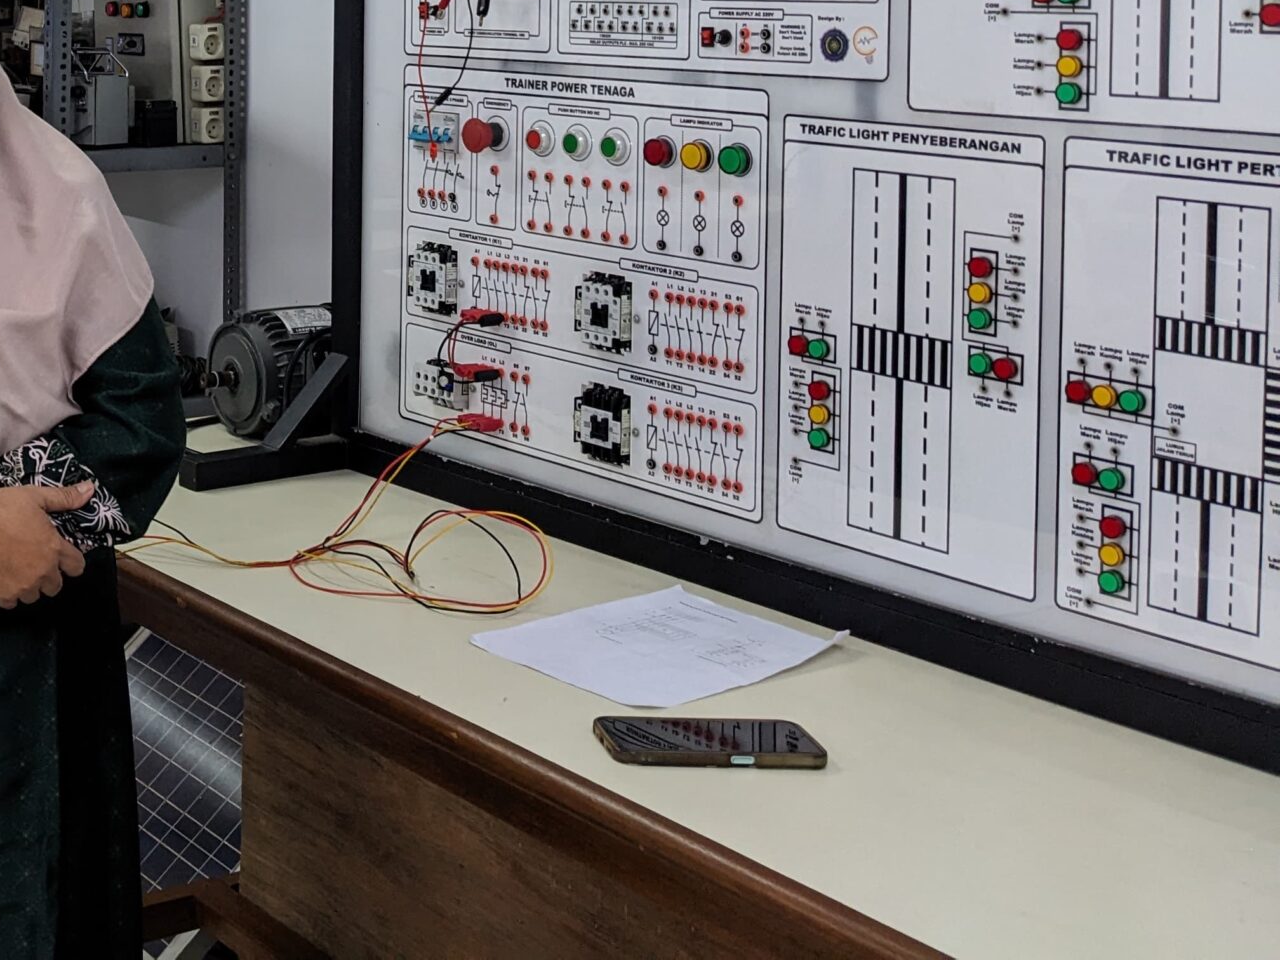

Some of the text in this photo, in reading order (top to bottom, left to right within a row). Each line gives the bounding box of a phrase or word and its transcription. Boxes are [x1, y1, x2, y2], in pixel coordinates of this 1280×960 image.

[505, 77, 635, 98] TRAINER POWER TENAGA
[800, 123, 1021, 154] TRAFIC LIGHT PENYEBERANGAN
[1106, 149, 1171, 168] TRAFIC
[1175, 156, 1233, 174] LIGHT
[632, 263, 667, 275] KONTAKTOR
[630, 375, 667, 388] KONTAKTOR
